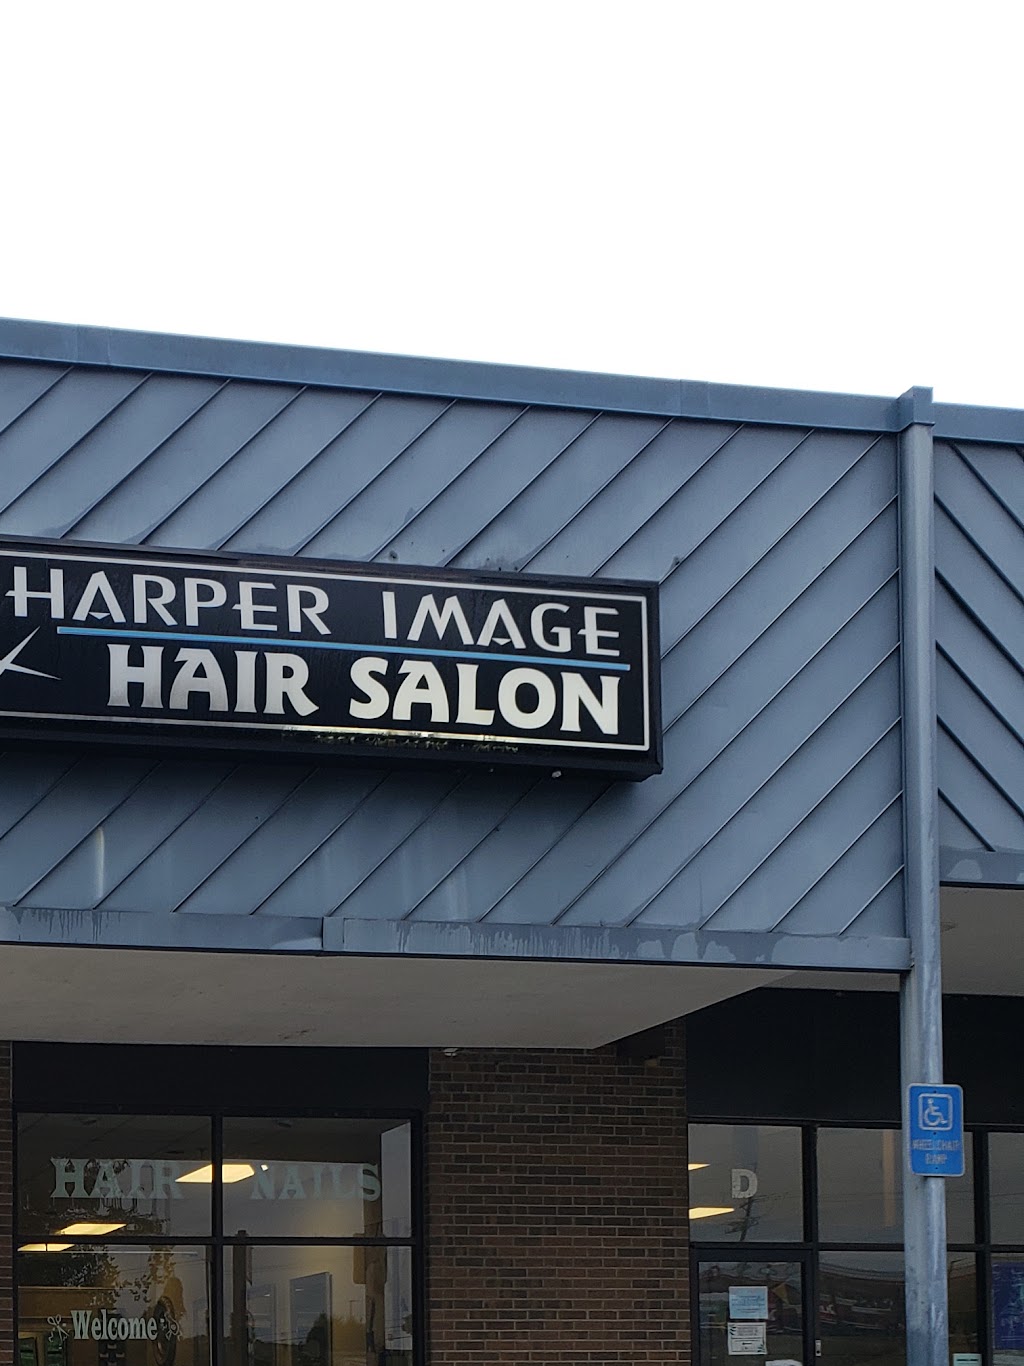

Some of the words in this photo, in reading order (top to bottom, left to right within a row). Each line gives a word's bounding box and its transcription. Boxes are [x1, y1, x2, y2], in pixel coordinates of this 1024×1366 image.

[381, 590, 621, 657] IMAGE
[106, 643, 320, 717] HAIR
[348, 656, 622, 735] SALON
[50, 1157, 184, 1199] HAIR
[250, 1162, 381, 1201] NAILS
[731, 1168, 758, 1199] D
[70, 1308, 158, 1341] Welcome
